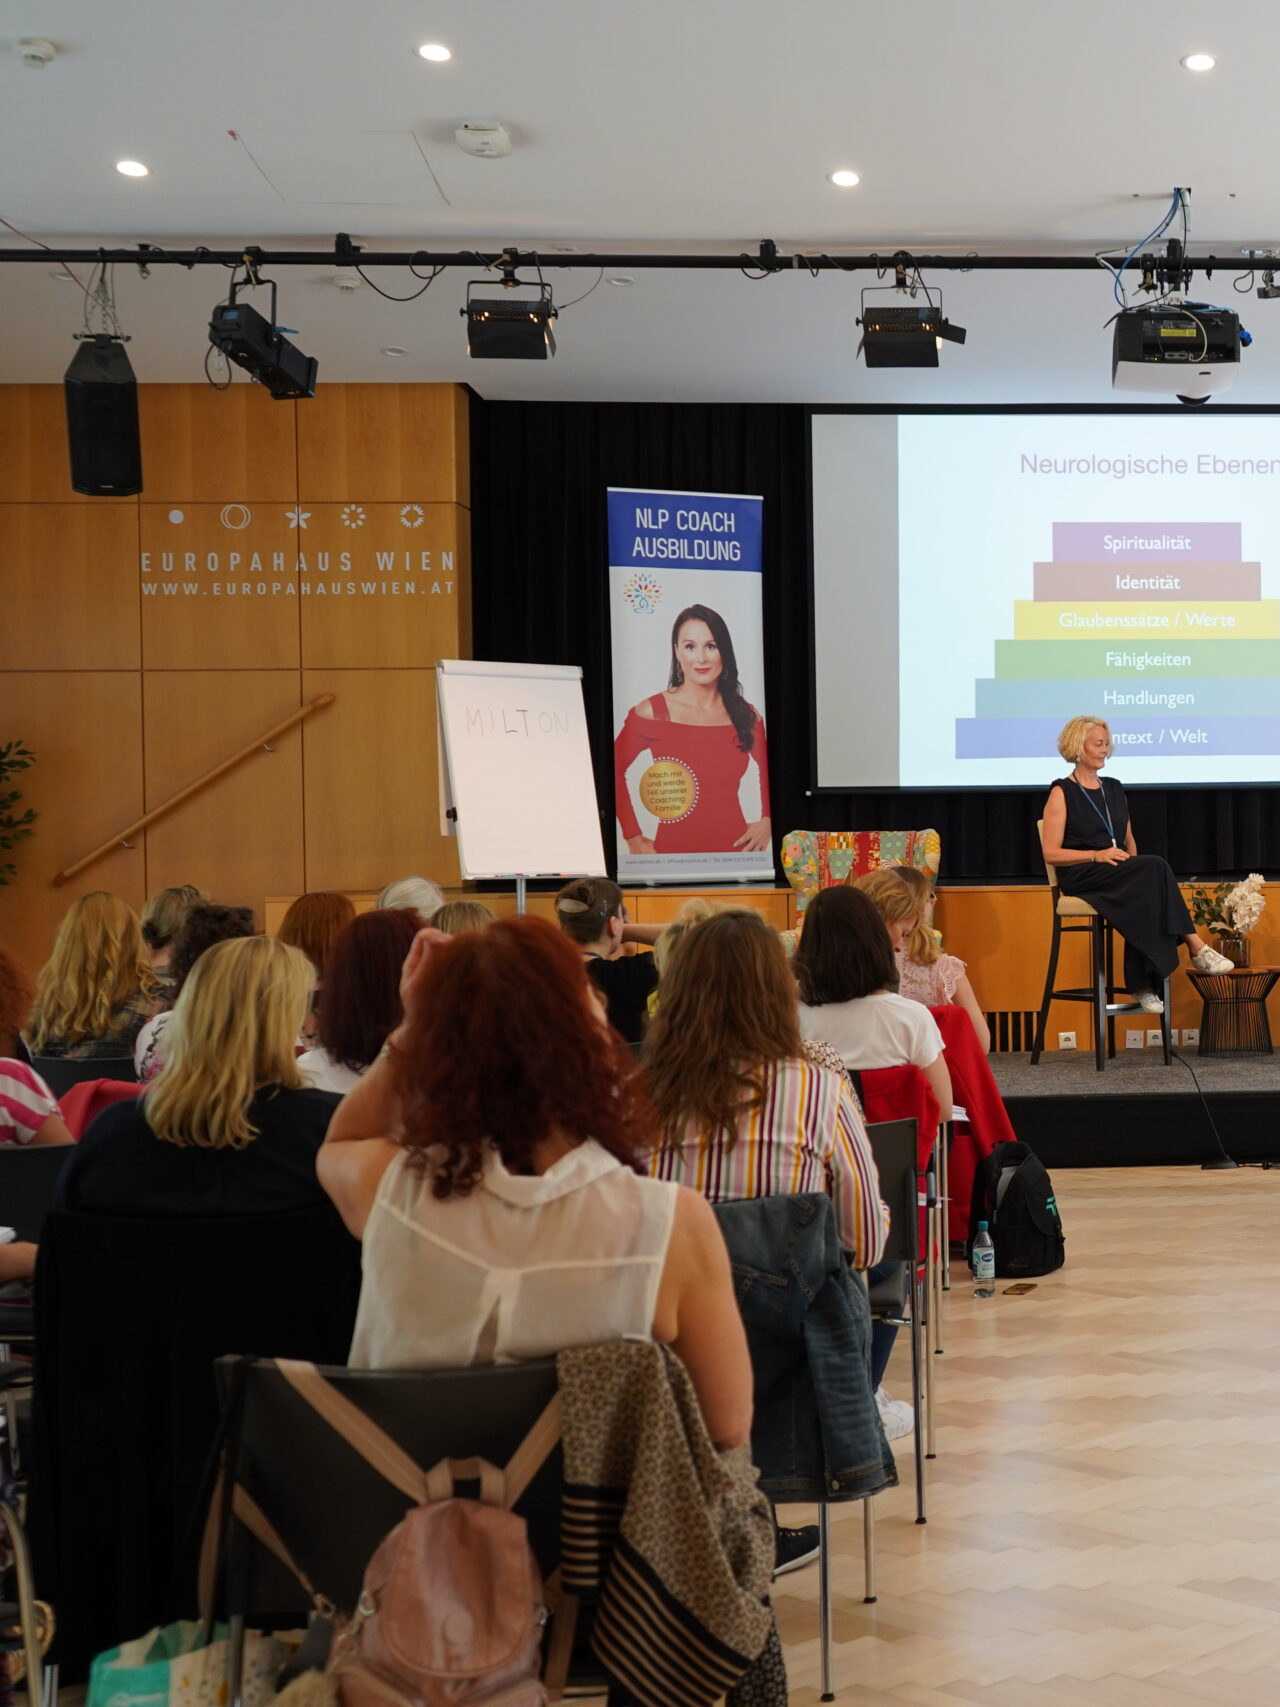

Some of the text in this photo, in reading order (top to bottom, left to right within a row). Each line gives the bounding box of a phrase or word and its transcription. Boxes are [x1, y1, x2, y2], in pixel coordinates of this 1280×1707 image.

[1020, 453, 1188, 479] Neurologische
[635, 507, 735, 533] NLP COACH
[632, 536, 741, 562] AUSBILDUNG
[1103, 534, 1192, 554] Spiritualität
[141, 551, 455, 572] EUROPAHAUS WIEN
[142, 581, 455, 596] WWW.EUROPAHAUSWIEN.AT
[1116, 575, 1181, 590] Identität
[1058, 612, 1170, 628] Glaubenssätze
[1185, 612, 1237, 628] Werte
[1106, 651, 1192, 671] Fähigkeiten
[1103, 690, 1195, 709] Handlungen
[464, 706, 570, 739] MILTON
[1112, 731, 1154, 745] ntext
[1169, 729, 1209, 744] Welt
[671, 770, 683, 778] mit
[650, 796, 686, 805] Coaching
